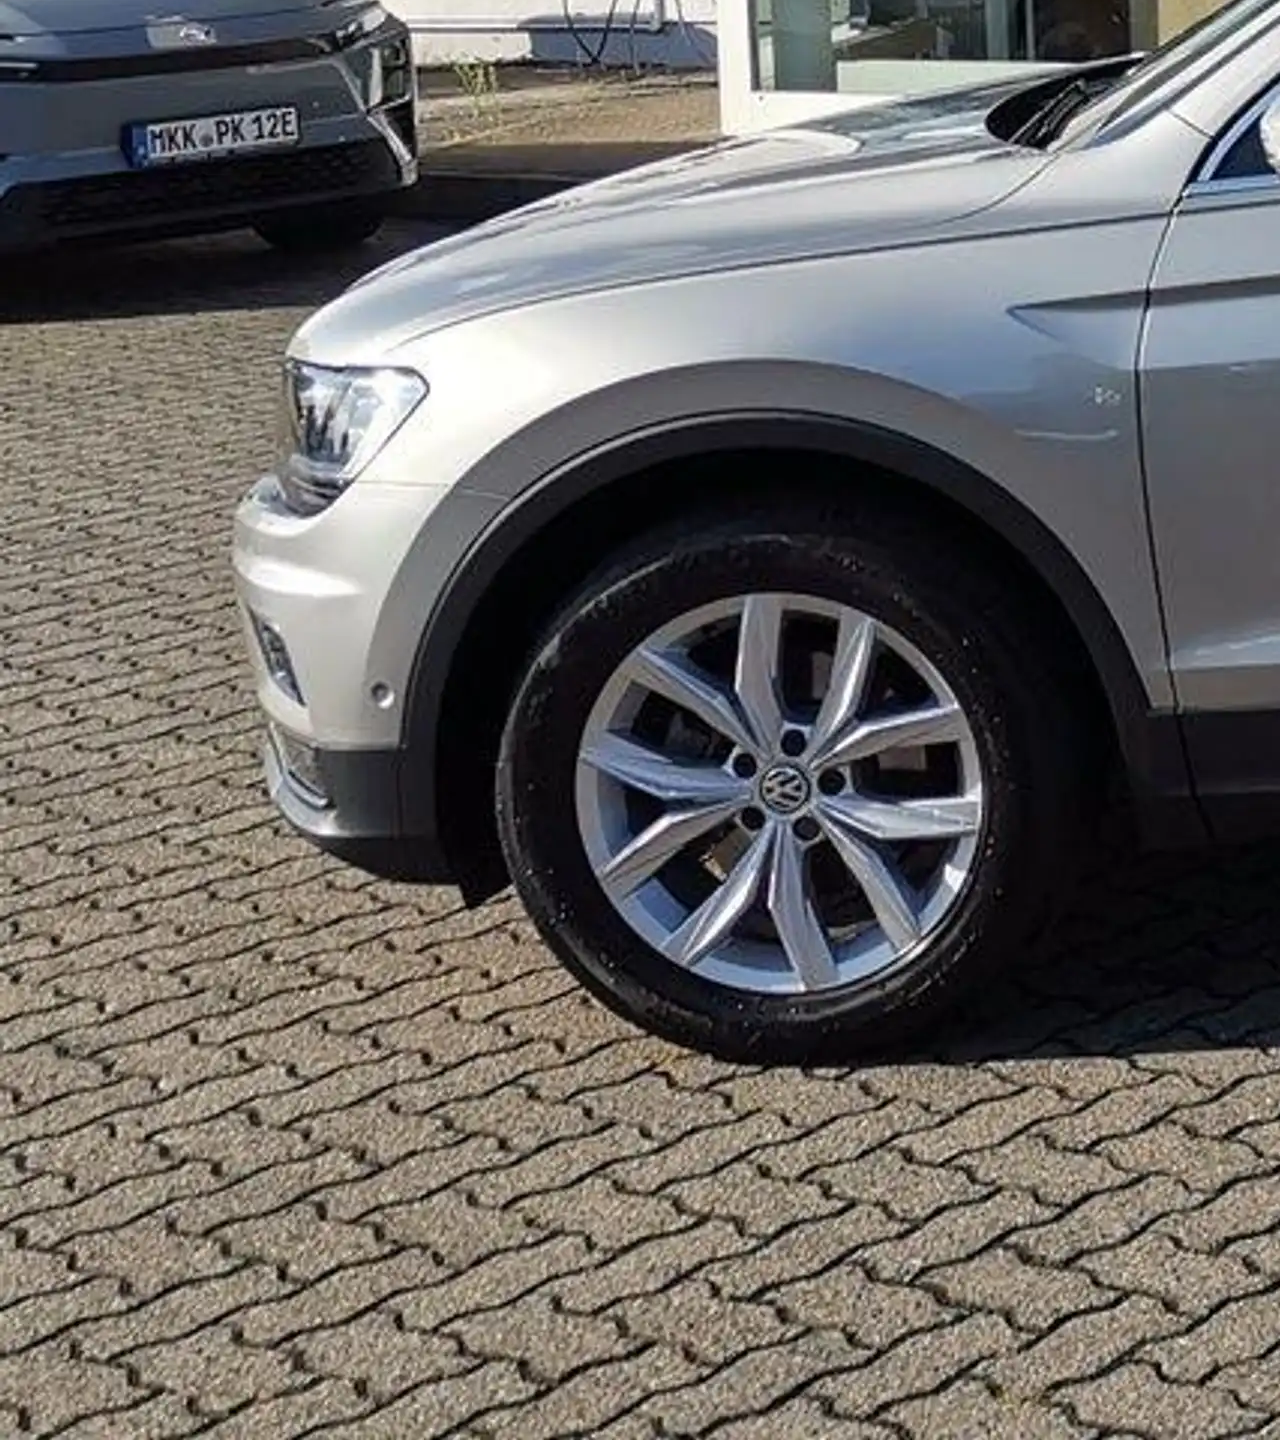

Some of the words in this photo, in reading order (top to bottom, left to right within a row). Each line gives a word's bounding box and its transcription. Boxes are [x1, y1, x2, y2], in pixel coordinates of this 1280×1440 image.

[151, 123, 198, 155] MKK
[214, 116, 245, 144] PK
[251, 110, 295, 140] 12E
